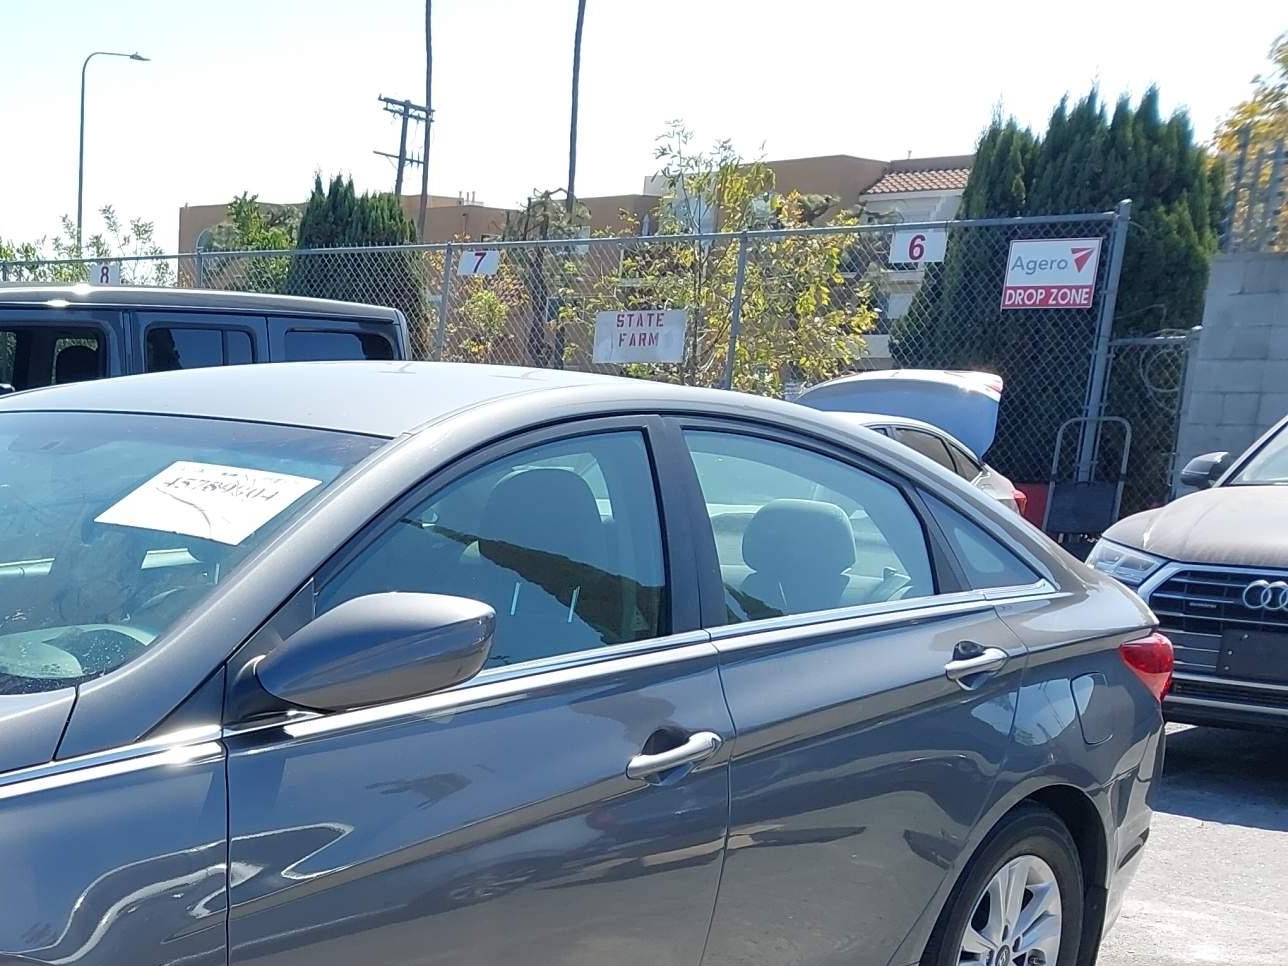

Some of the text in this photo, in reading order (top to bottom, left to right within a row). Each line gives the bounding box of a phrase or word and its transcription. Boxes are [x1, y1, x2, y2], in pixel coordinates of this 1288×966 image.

[908, 234, 926, 261] 6
[473, 252, 487, 273] 7
[1011, 255, 1068, 275] Agero
[100, 266, 109, 283] 8
[1004, 288, 1090, 305] DROP ZONE
[616, 313, 665, 327] STATE
[618, 332, 660, 347] FARM
